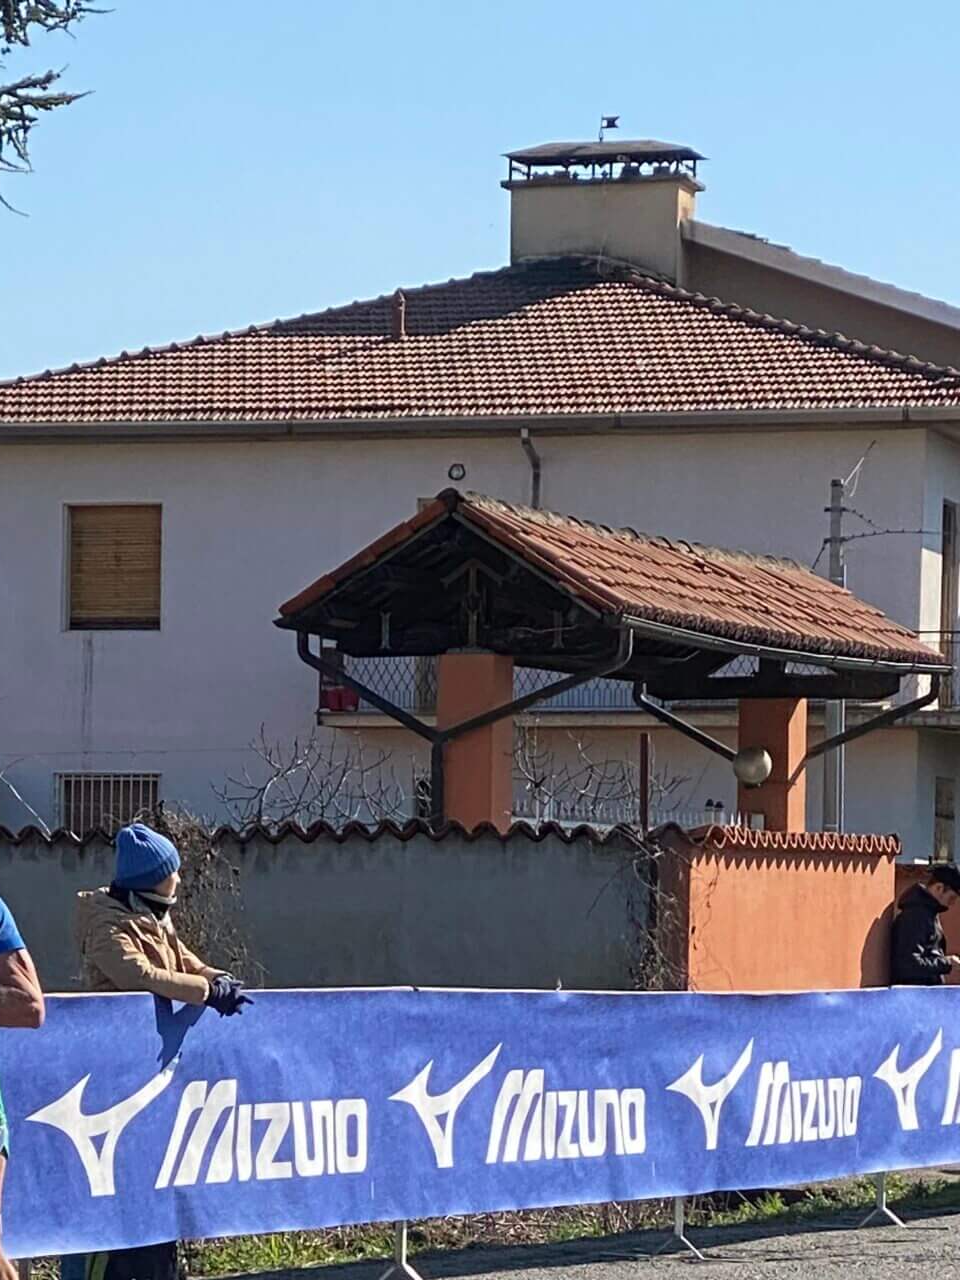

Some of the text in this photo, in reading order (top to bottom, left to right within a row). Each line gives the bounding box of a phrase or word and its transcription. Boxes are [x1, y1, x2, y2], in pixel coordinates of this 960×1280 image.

[155, 1079, 368, 1197] MIZUNO
[486, 1069, 647, 1167] MIZUNO
[745, 1061, 862, 1147] MIZUNO
